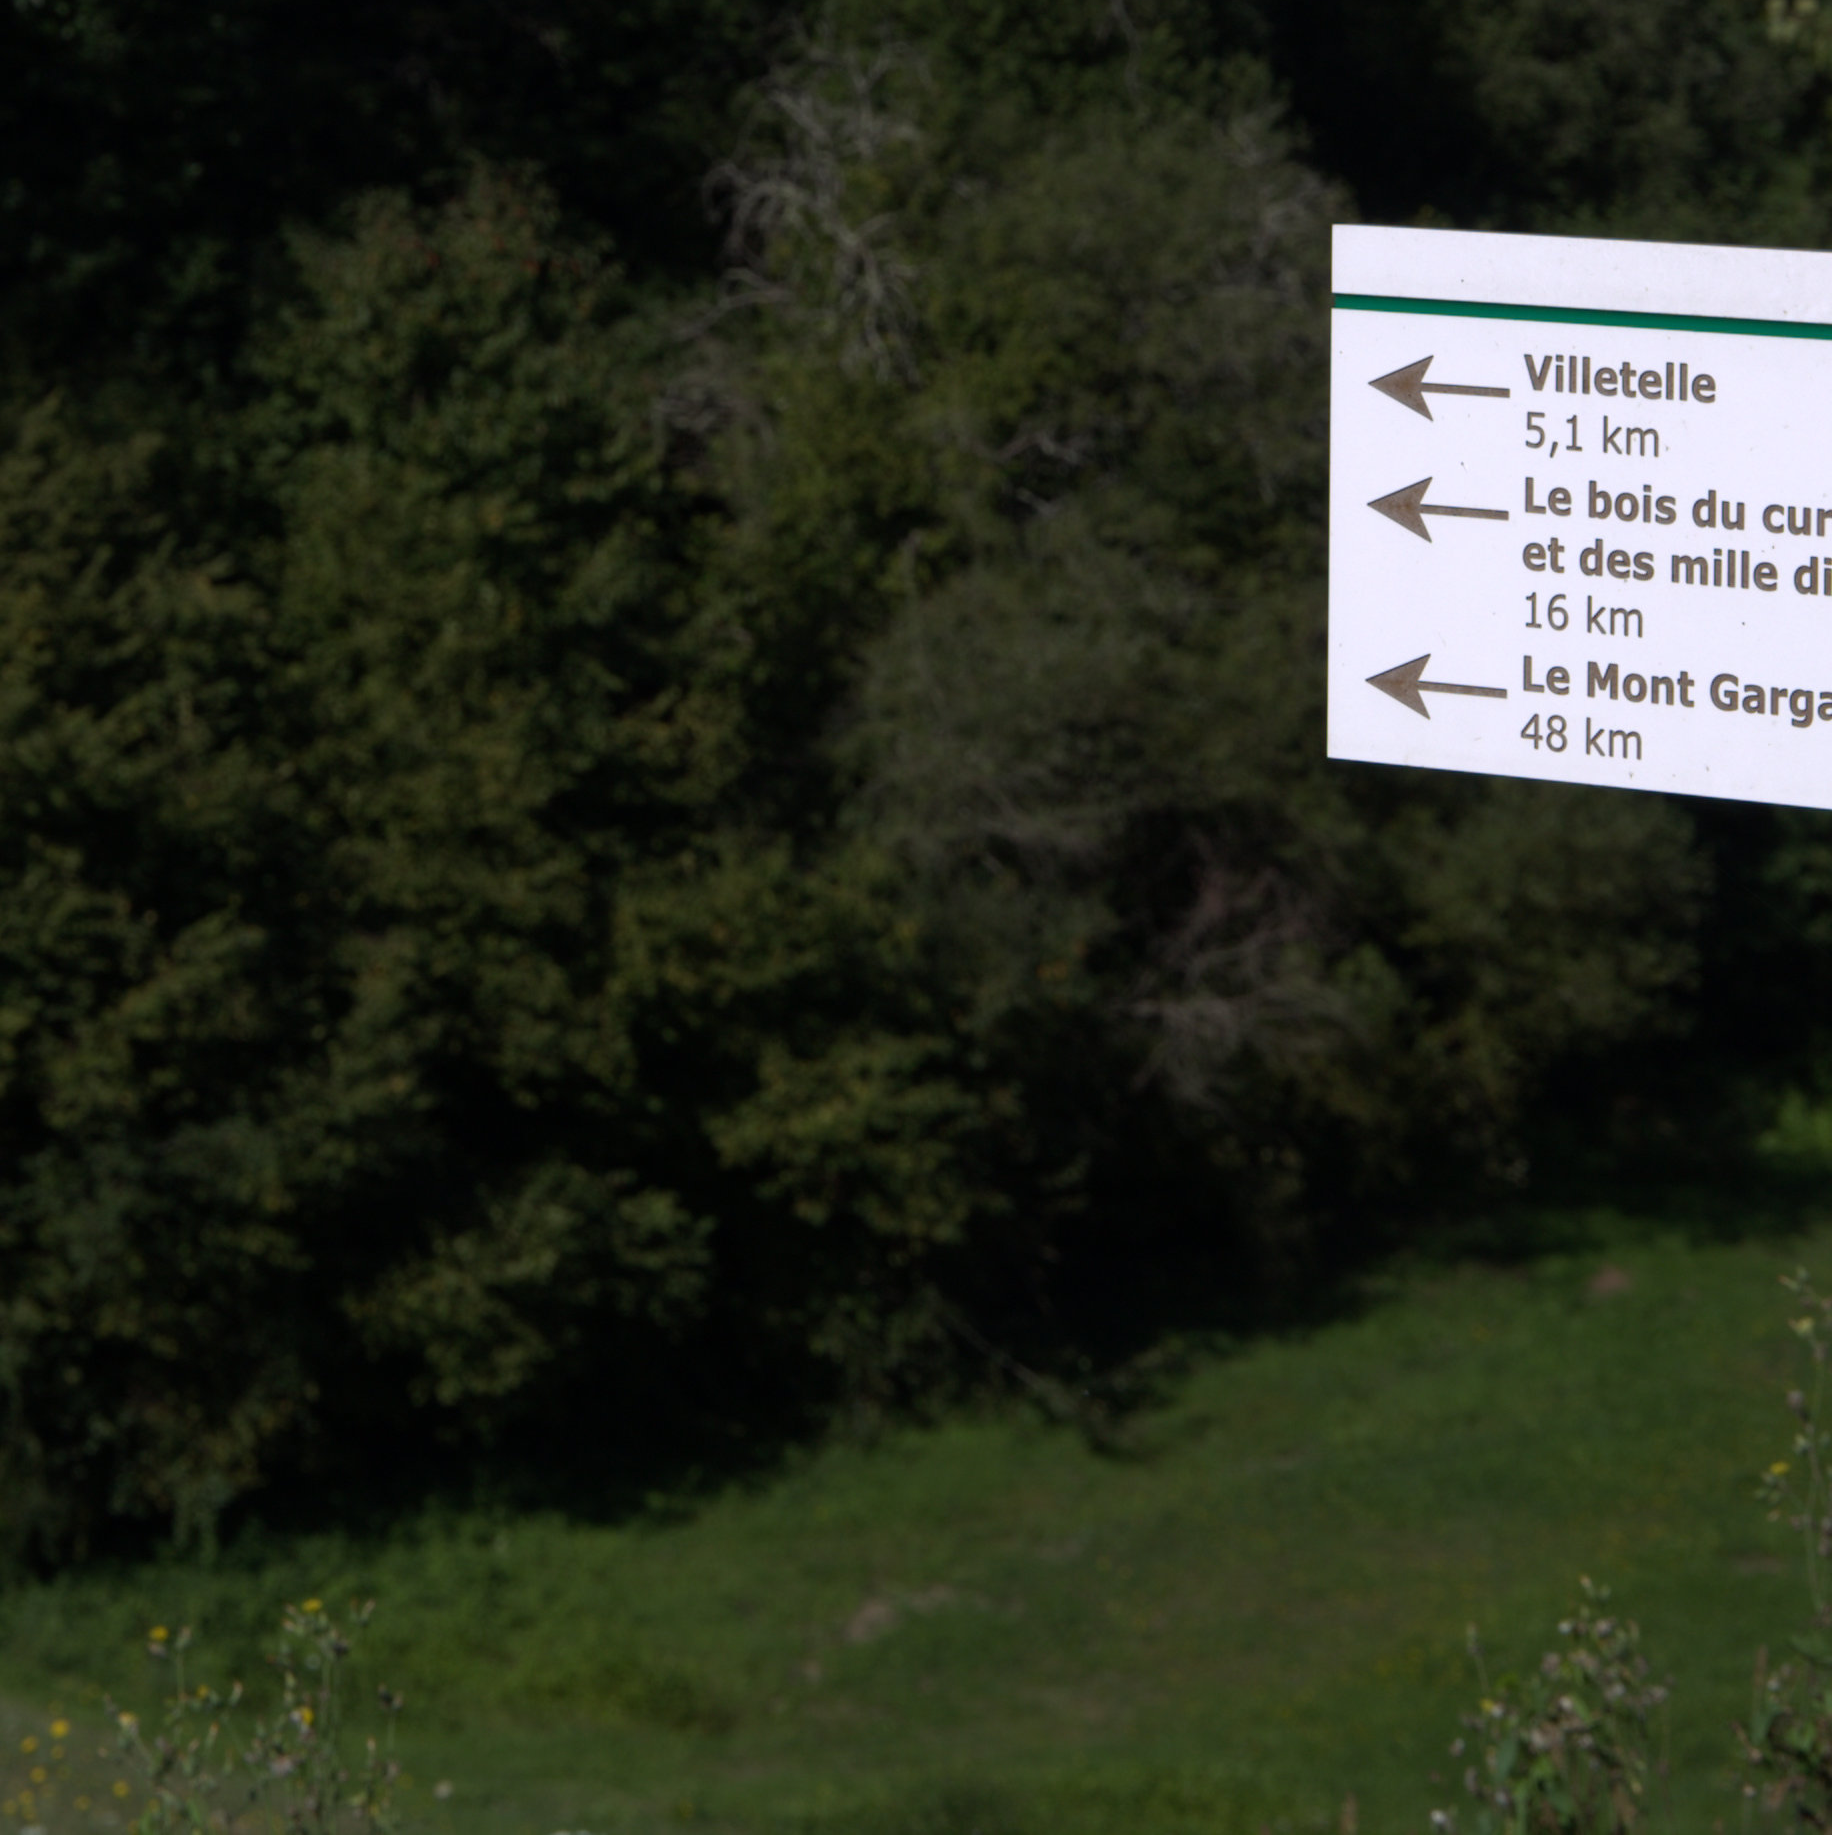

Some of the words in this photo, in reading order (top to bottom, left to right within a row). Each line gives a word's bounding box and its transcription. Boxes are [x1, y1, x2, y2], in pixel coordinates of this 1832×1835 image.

[1523, 353, 1716, 404] Villetelle
[1525, 411, 1583, 457] 5,1
[1602, 415, 1659, 458] km
[1524, 476, 1572, 517] Le
[1588, 479, 1677, 525] bois
[1691, 489, 1745, 531] du
[1522, 537, 1565, 574] et
[1579, 538, 1655, 582] des
[1671, 547, 1778, 592] mille
[1525, 591, 1569, 631] 16
[1586, 595, 1643, 638] km
[1523, 654, 1570, 696] Le
[1586, 660, 1695, 708] Mont
[1520, 713, 1568, 753] 48
[1585, 716, 1642, 761] km
